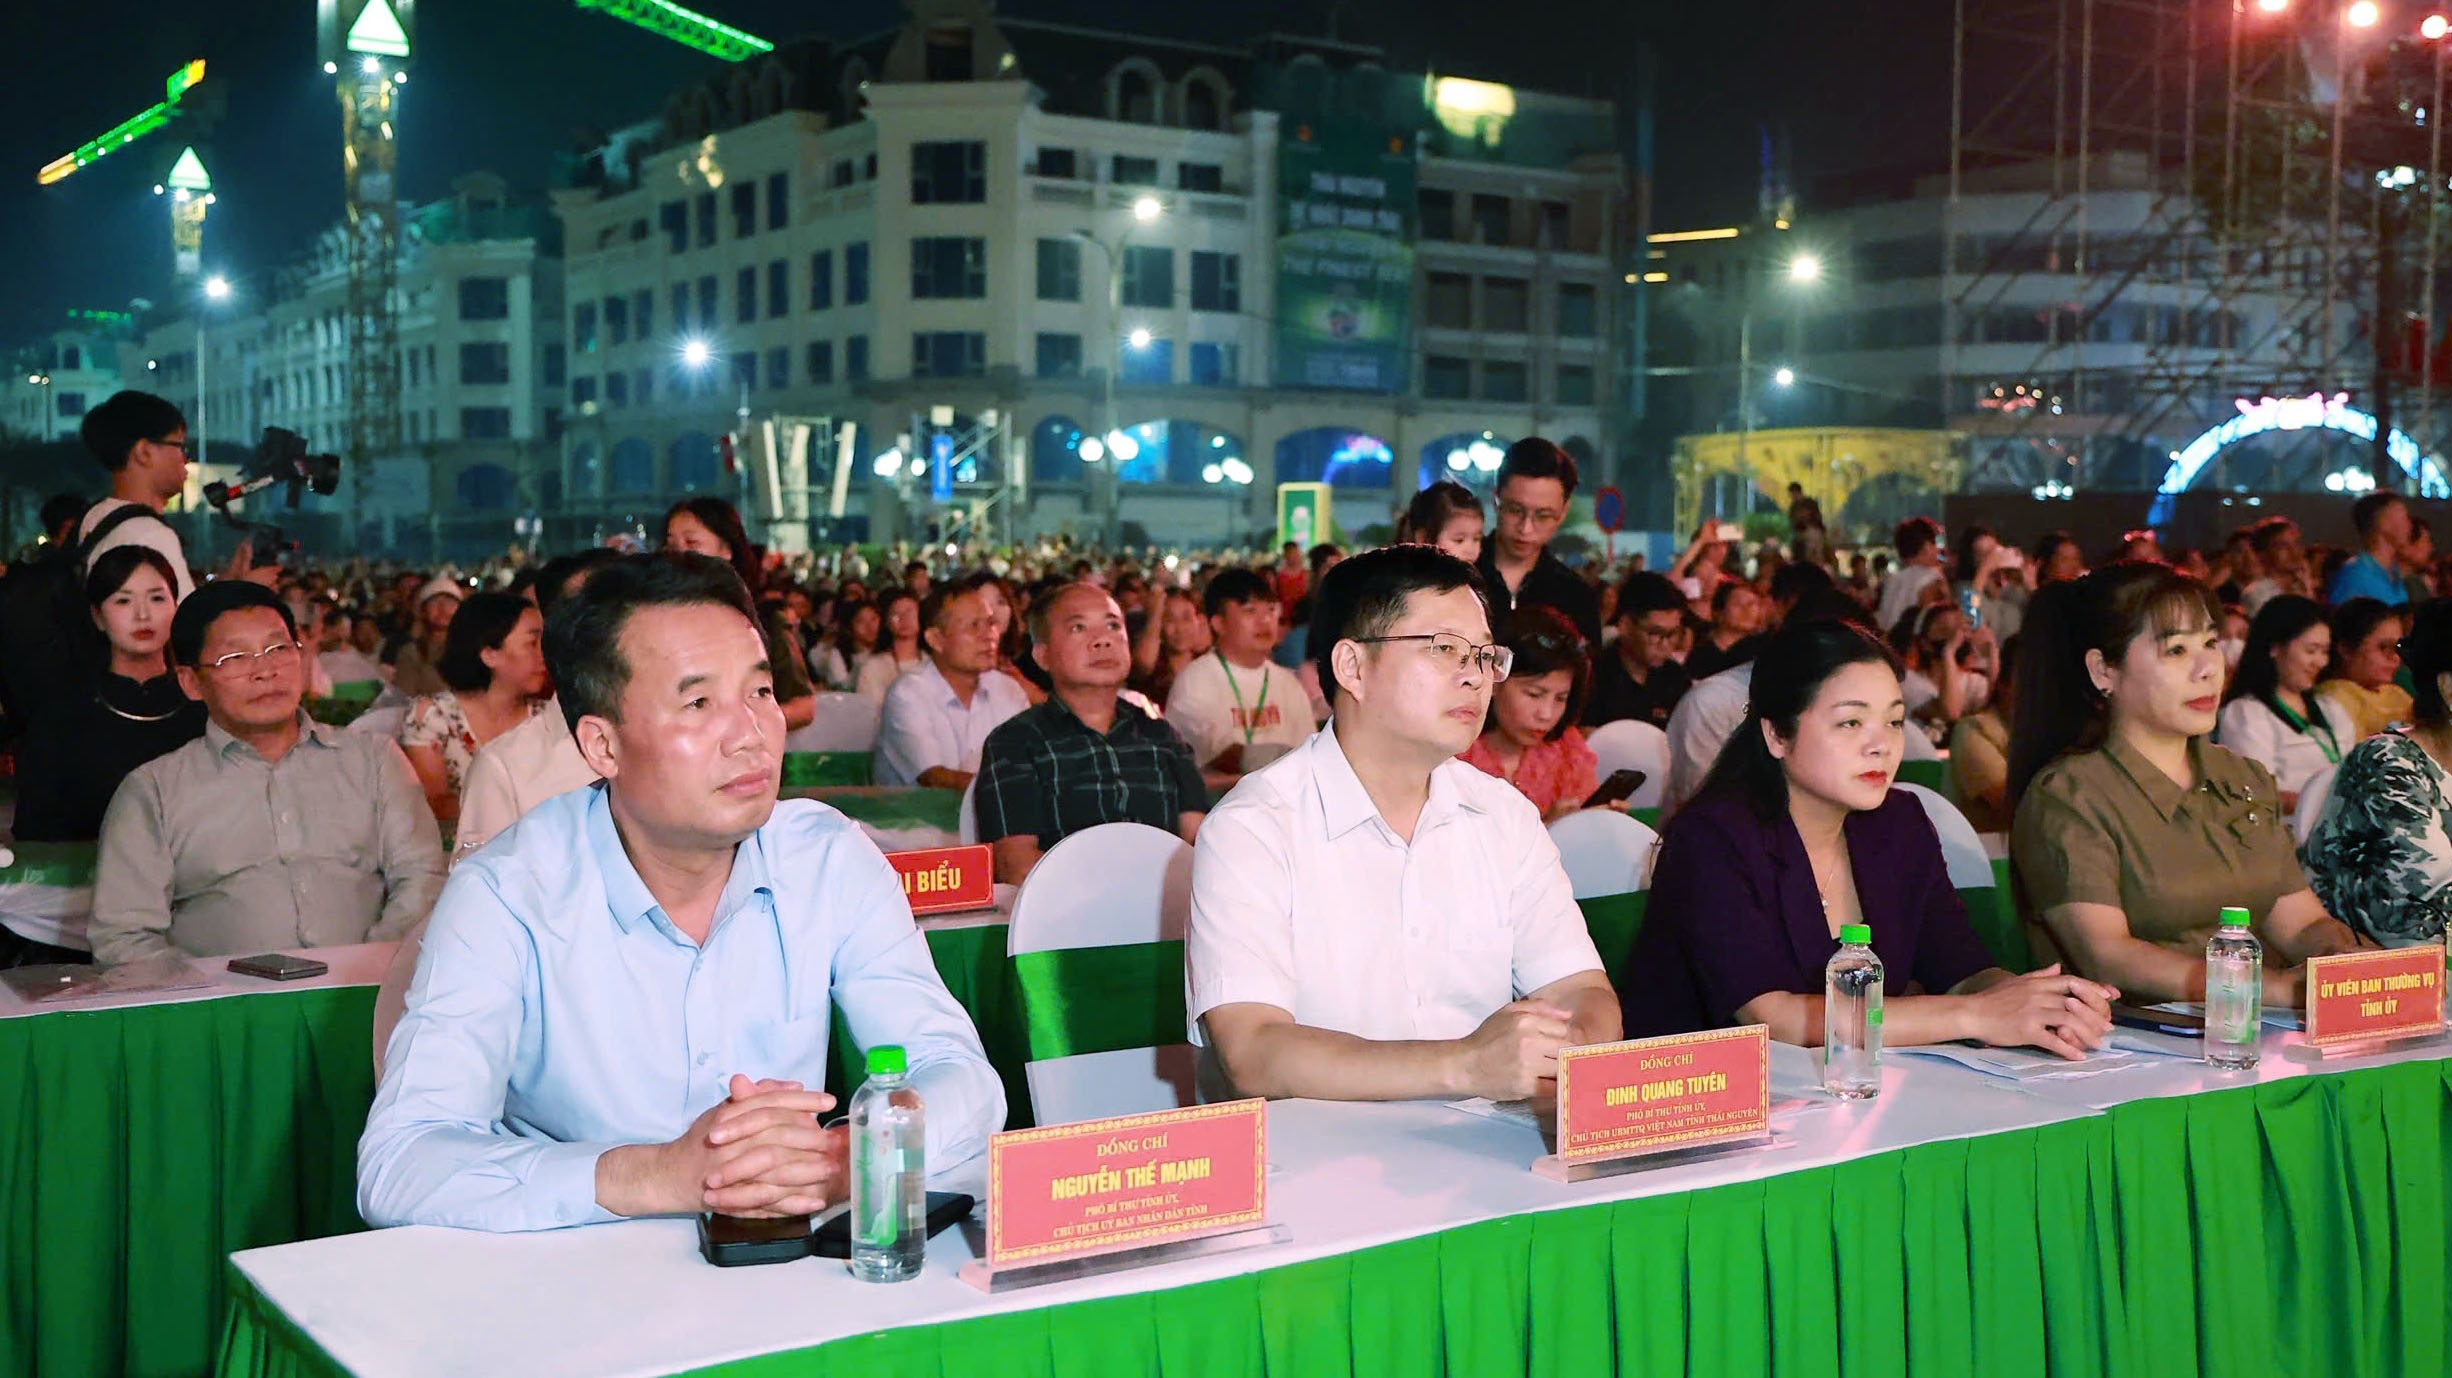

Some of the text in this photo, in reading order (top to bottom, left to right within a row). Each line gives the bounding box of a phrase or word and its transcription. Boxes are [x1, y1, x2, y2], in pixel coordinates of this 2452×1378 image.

[917, 859, 961, 893] BIỂU
[2321, 971, 2435, 998] ỦY VIÊN BAN THƯỜNG VỤ
[2361, 995, 2398, 1017] TỈNH ỦY
[1640, 1050, 1694, 1070] ĐỒNG CHÍ
[1606, 1071, 1727, 1106] ĐINH QUANG TUYÊN
[1666, 1119, 1684, 1129] NAM
[1097, 1132, 1169, 1157] ĐỒNG CHÍ
[1052, 1157, 1211, 1200] NGUYỄN THẾ MẠNH
